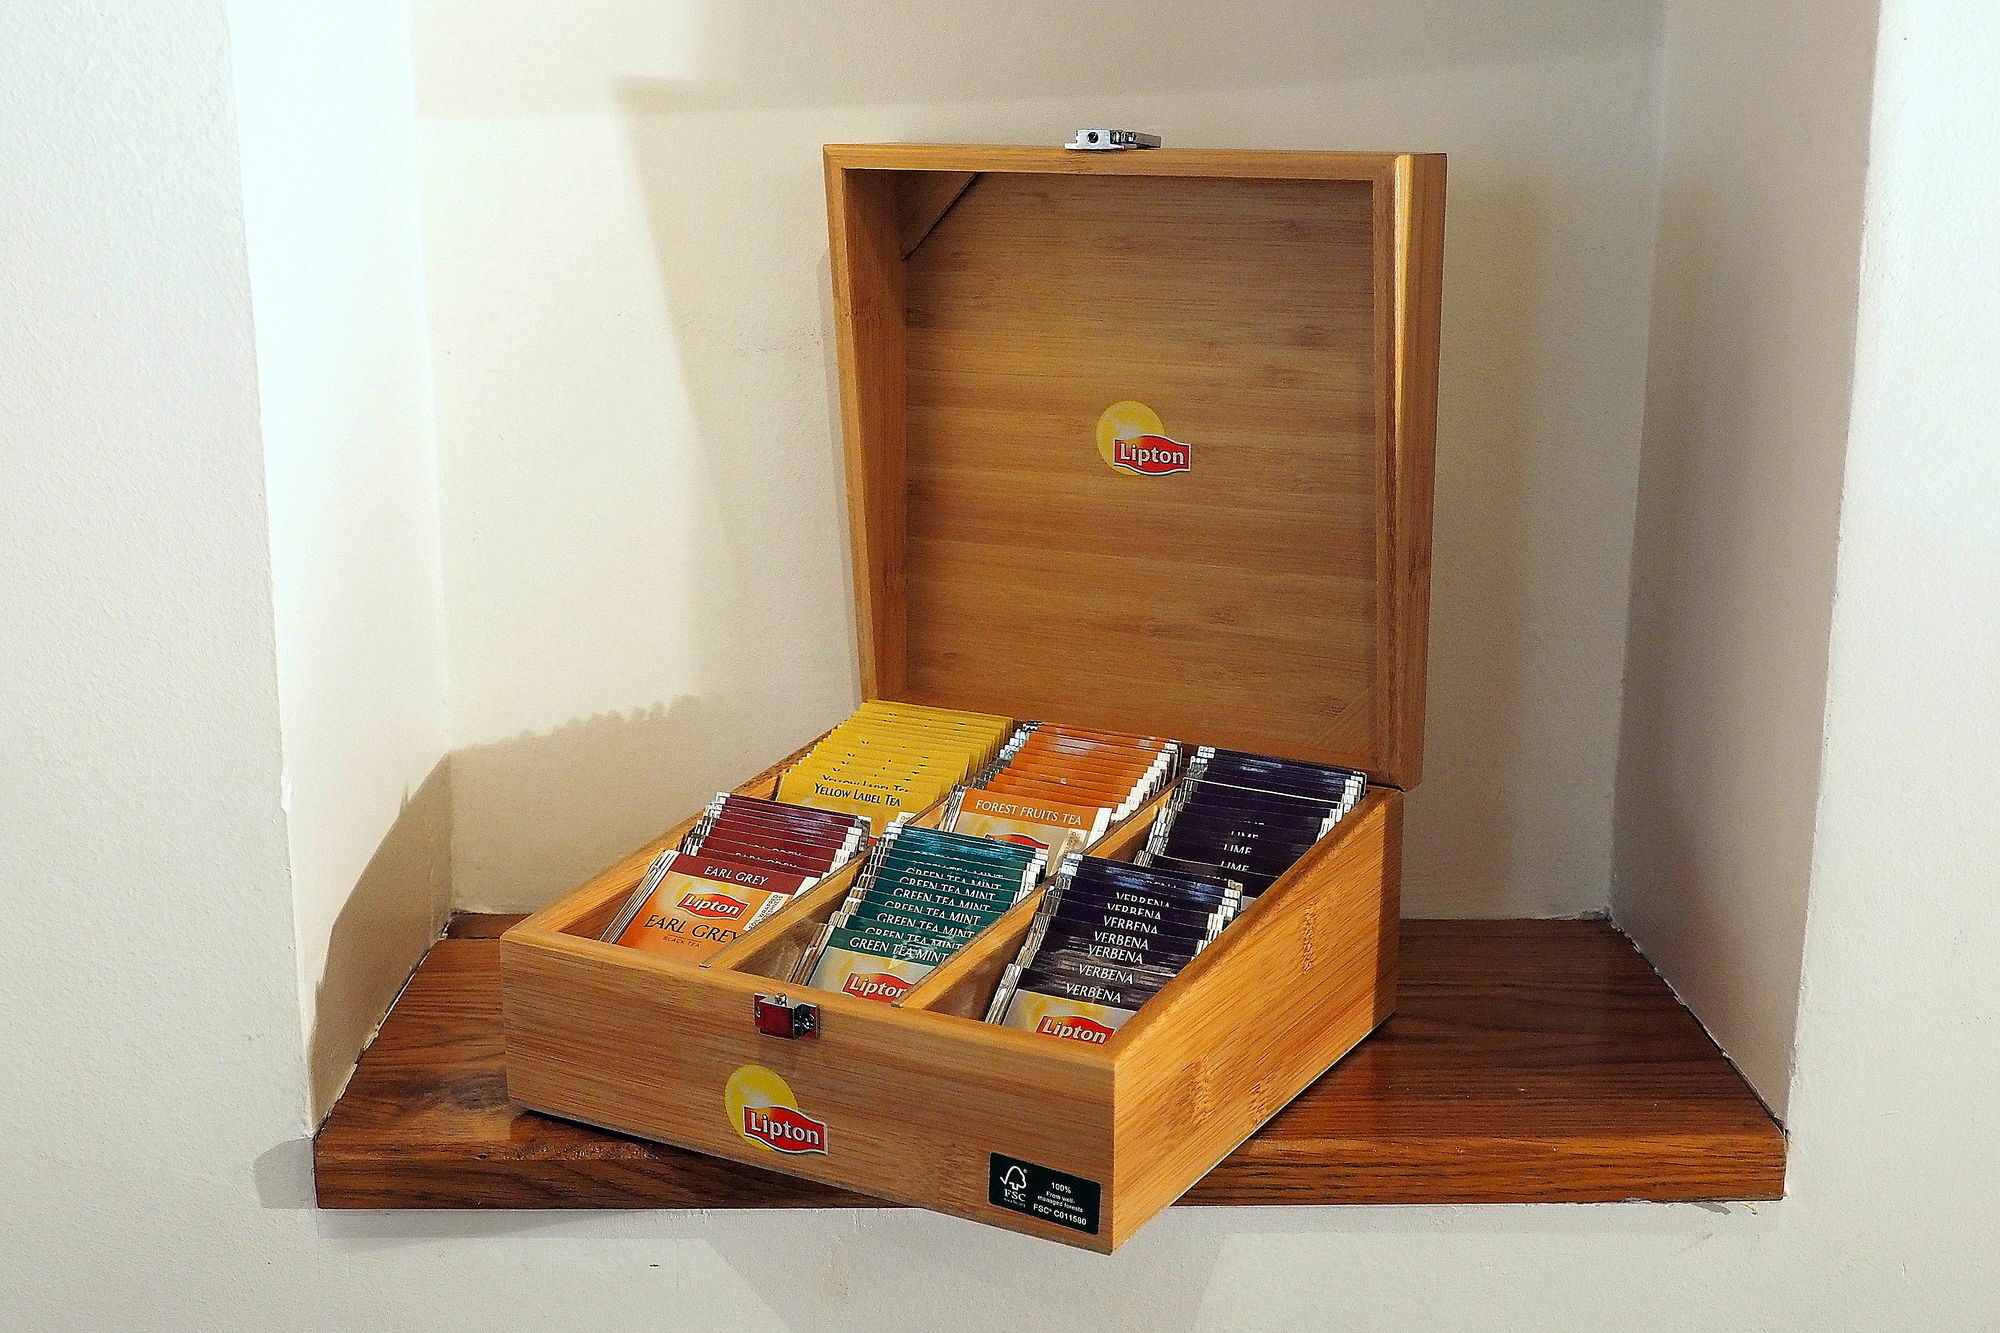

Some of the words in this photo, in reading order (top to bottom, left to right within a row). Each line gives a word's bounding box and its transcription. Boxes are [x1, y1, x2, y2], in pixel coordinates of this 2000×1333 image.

[1120, 443, 1185, 467] Lipton
[814, 782, 852, 799] YELLOW
[853, 789, 881, 805] LABEL
[885, 794, 901, 808] TEA
[975, 800, 1018, 815] FOREST
[1020, 806, 1059, 822] FRUITS
[1062, 813, 1082, 826] TEA
[703, 865, 733, 879] EARL
[735, 871, 769, 887] GREY
[684, 895, 740, 915] Lipton
[644, 914, 688, 934] EARL
[877, 912, 917, 928] GREEN
[949, 911, 981, 926] MINT
[1103, 915, 1158, 935] VERBENA
[849, 936, 890, 953] GREEN
[915, 948, 949, 963] MINT
[1094, 931, 1149, 951] VERBENA
[1088, 944, 1143, 965] VERBENA
[1079, 963, 1134, 985] VERBENA
[1066, 982, 1121, 1003] VERBENA
[1042, 1019, 1107, 1044] Lipton
[750, 1112, 819, 1145] Lipton
[1004, 1188, 1026, 1202] FSC
[1051, 1182, 1072, 1194] 100%
